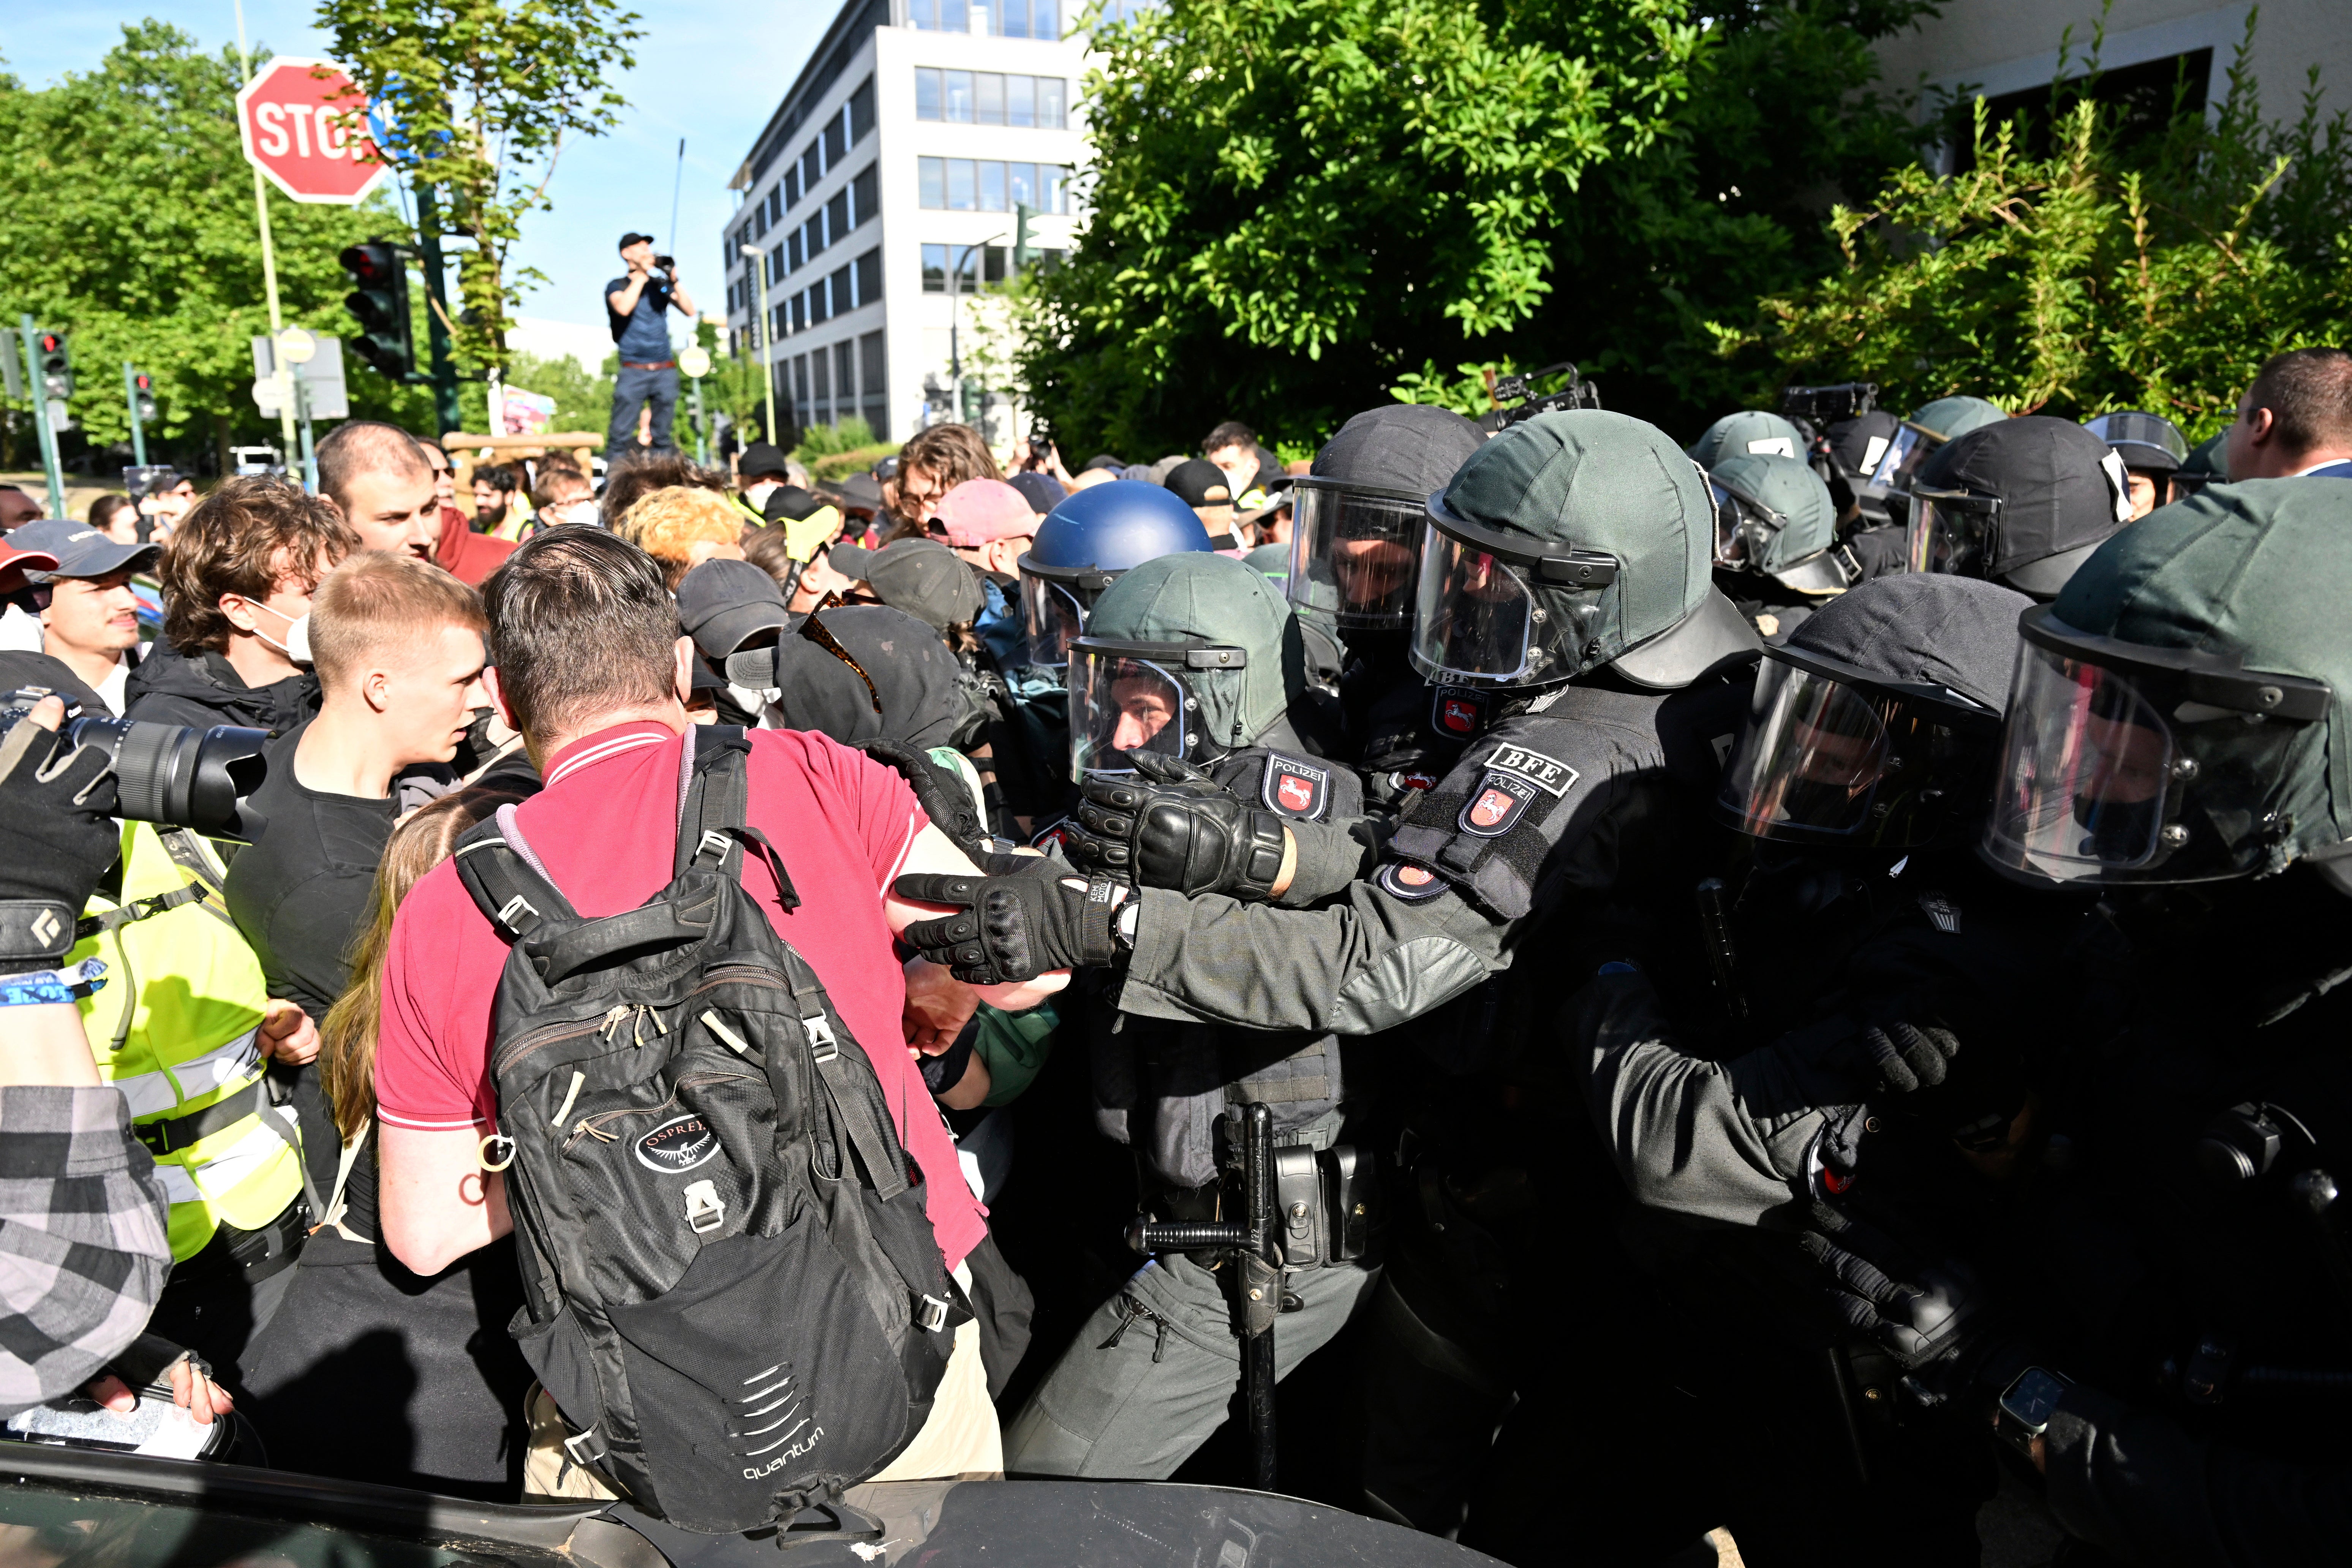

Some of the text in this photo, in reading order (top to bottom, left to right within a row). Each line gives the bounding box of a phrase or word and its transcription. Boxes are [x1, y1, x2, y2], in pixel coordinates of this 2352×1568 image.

[1440, 688, 1485, 703] POLIZEI
[1275, 761, 1321, 781] POLIZEI
[1500, 750, 1562, 784] BFE
[1487, 776, 1531, 800] POLIZEI
[1090, 885, 1100, 901] KEMI
[1097, 883, 1107, 902] MOTO
[743, 1427, 824, 1479] quantum
